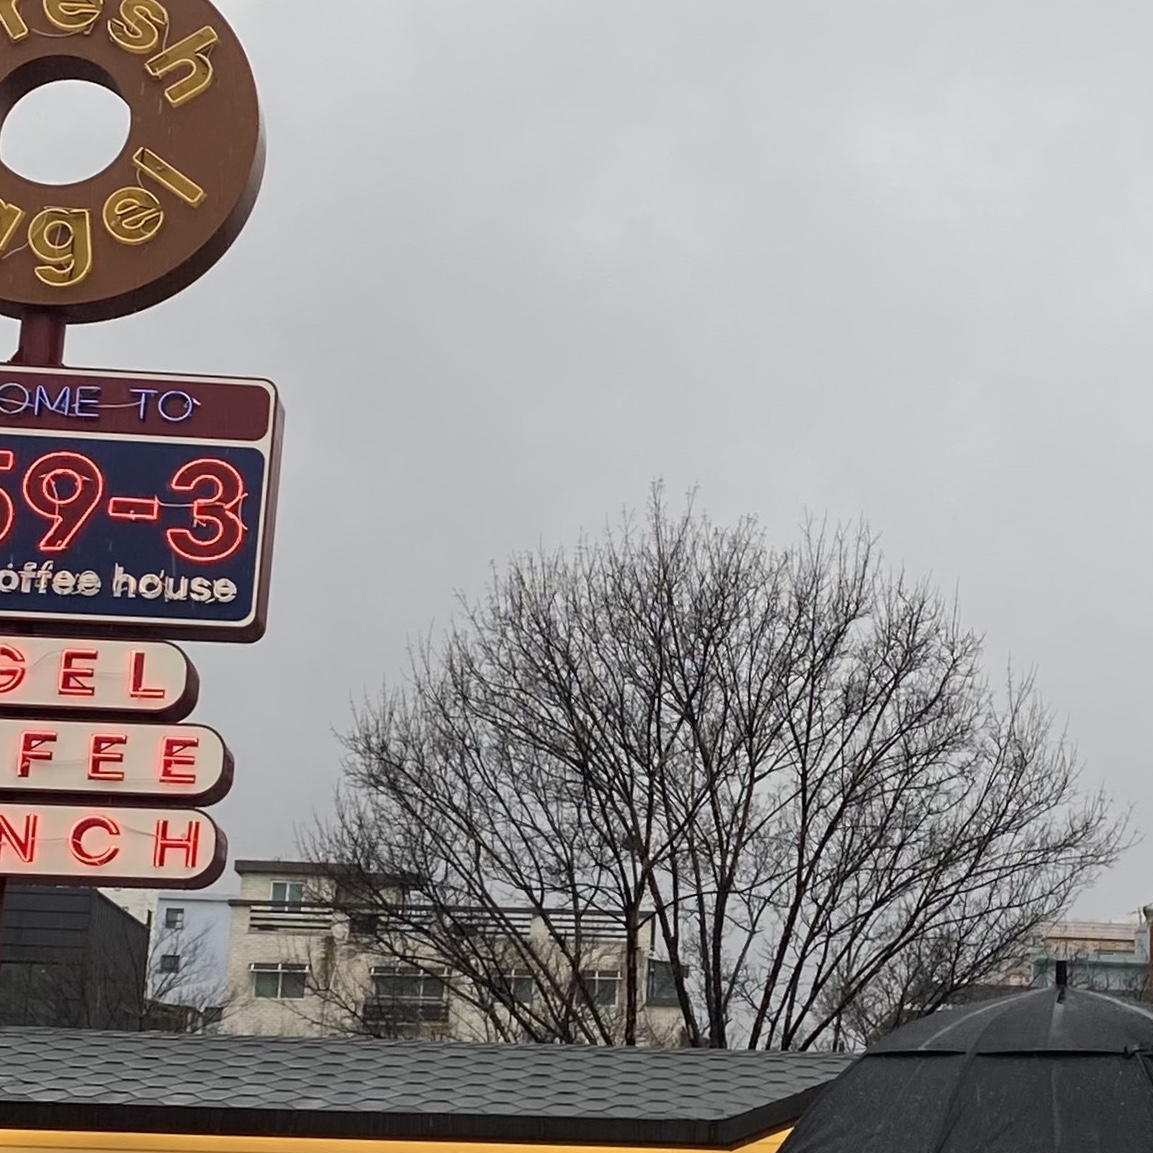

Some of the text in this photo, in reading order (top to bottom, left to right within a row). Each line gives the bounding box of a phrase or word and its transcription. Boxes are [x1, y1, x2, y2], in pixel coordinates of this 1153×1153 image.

[129, 388, 194, 421] TO
[111, 562, 238, 603] house
[16, 730, 200, 784] FEE
[0, 813, 201, 868] NCH
